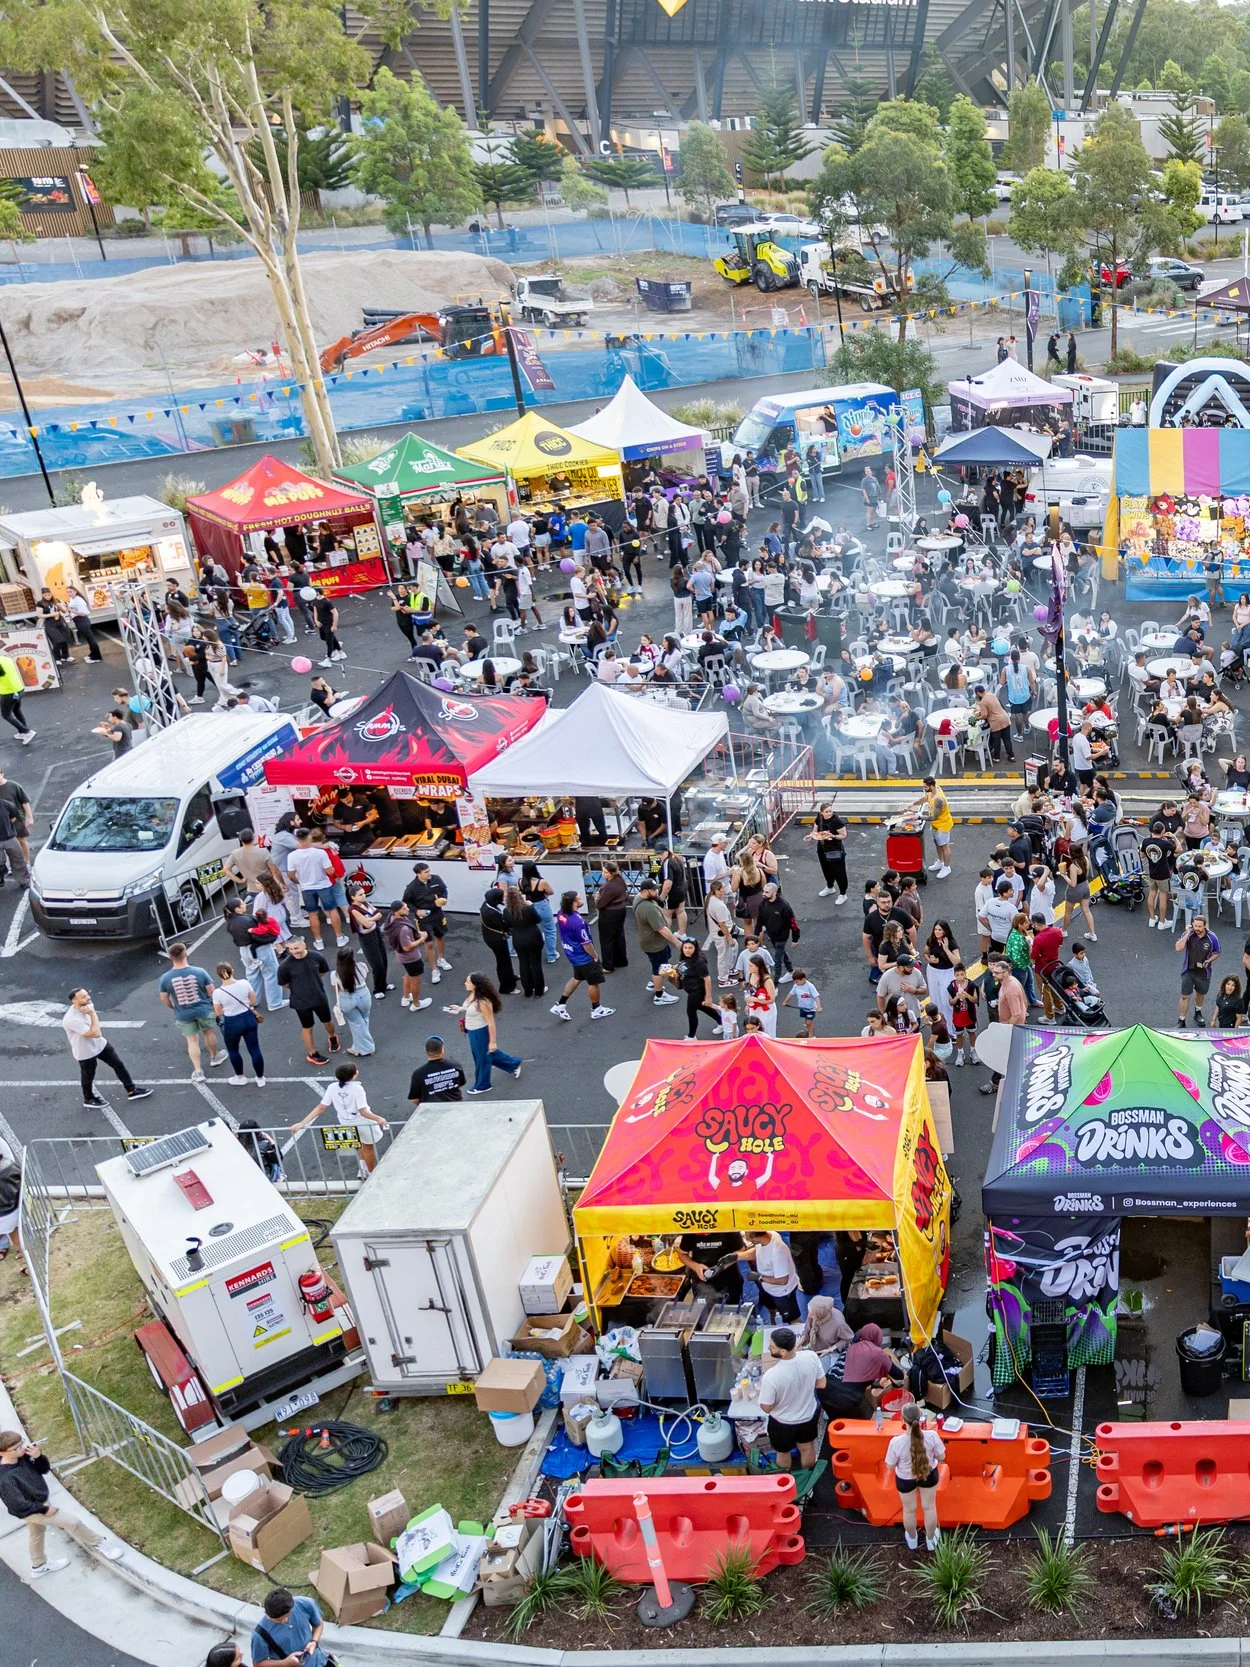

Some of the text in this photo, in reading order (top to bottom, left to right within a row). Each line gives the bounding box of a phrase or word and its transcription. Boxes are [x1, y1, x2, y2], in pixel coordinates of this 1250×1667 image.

[600, 140, 611, 155] C
[362, 334, 391, 352] HITACHI
[488, 440, 517, 451] THICC
[539, 436, 567, 451] THICC
[546, 459, 589, 471] THICC COOKIES
[291, 483, 325, 502] PUFF
[243, 518, 273, 532] FRESH
[275, 513, 293, 526] HOT
[294, 506, 343, 522] DOUGHNUT
[344, 501, 371, 514] BALLS
[414, 775, 460, 784] VIRAL DUBAI
[419, 784, 462, 797] WRAPS
[1057, 1052, 1073, 1100] BOSSMAN
[1208, 1054, 1226, 1095] BOSSMAN
[695, 1103, 794, 1144] SAUCY
[1111, 1110, 1165, 1126] BOSSMAN
[738, 1136, 785, 1154] HOLE
[1135, 1198, 1237, 1210] Bossman_experiences
[672, 1209, 719, 1226] SAUCY
[228, 1266, 274, 1292] KENNARDS
[259, 1274, 276, 1286] HIRE
[254, 1308, 274, 1320] 135 135
[447, 1383, 472, 1393] TF 36
